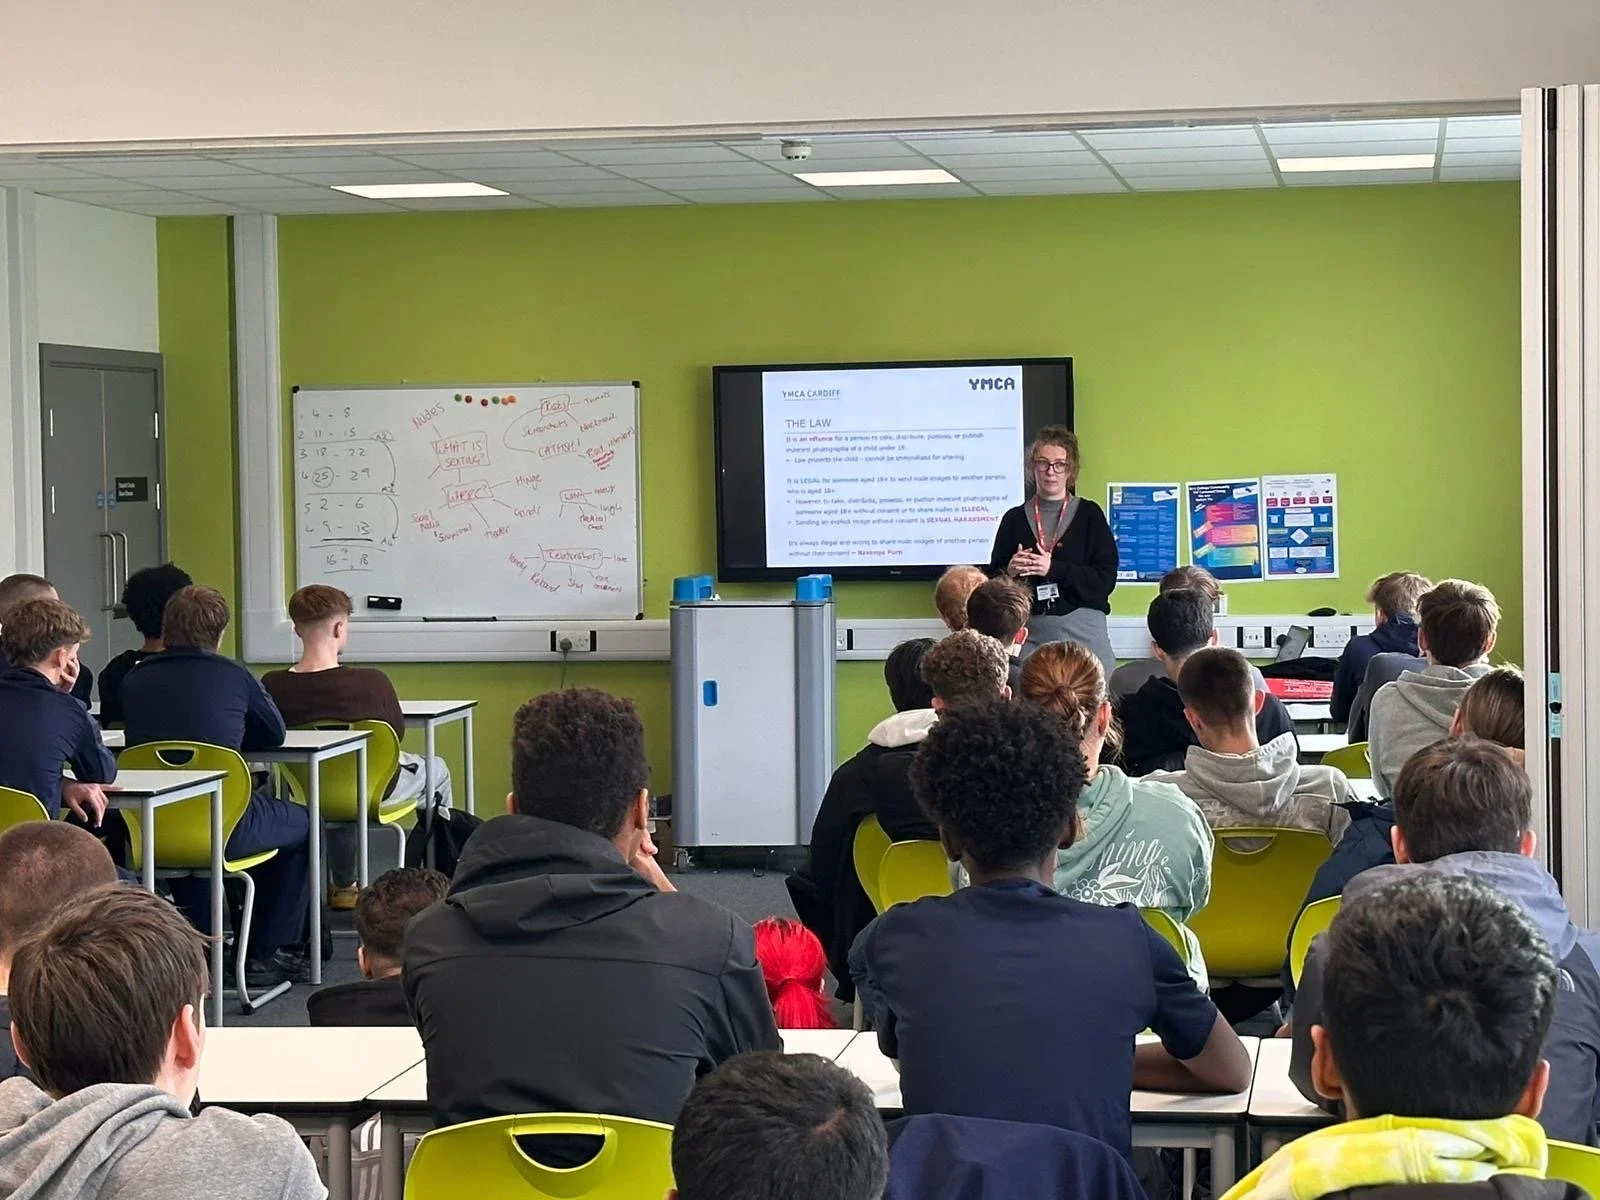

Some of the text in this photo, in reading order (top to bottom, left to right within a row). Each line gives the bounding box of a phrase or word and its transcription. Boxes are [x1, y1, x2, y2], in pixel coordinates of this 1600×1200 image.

[969, 377, 1015, 390] YMCA
[782, 389, 841, 398] YMCA CARDIFF
[785, 418, 832, 428] THE LAW
